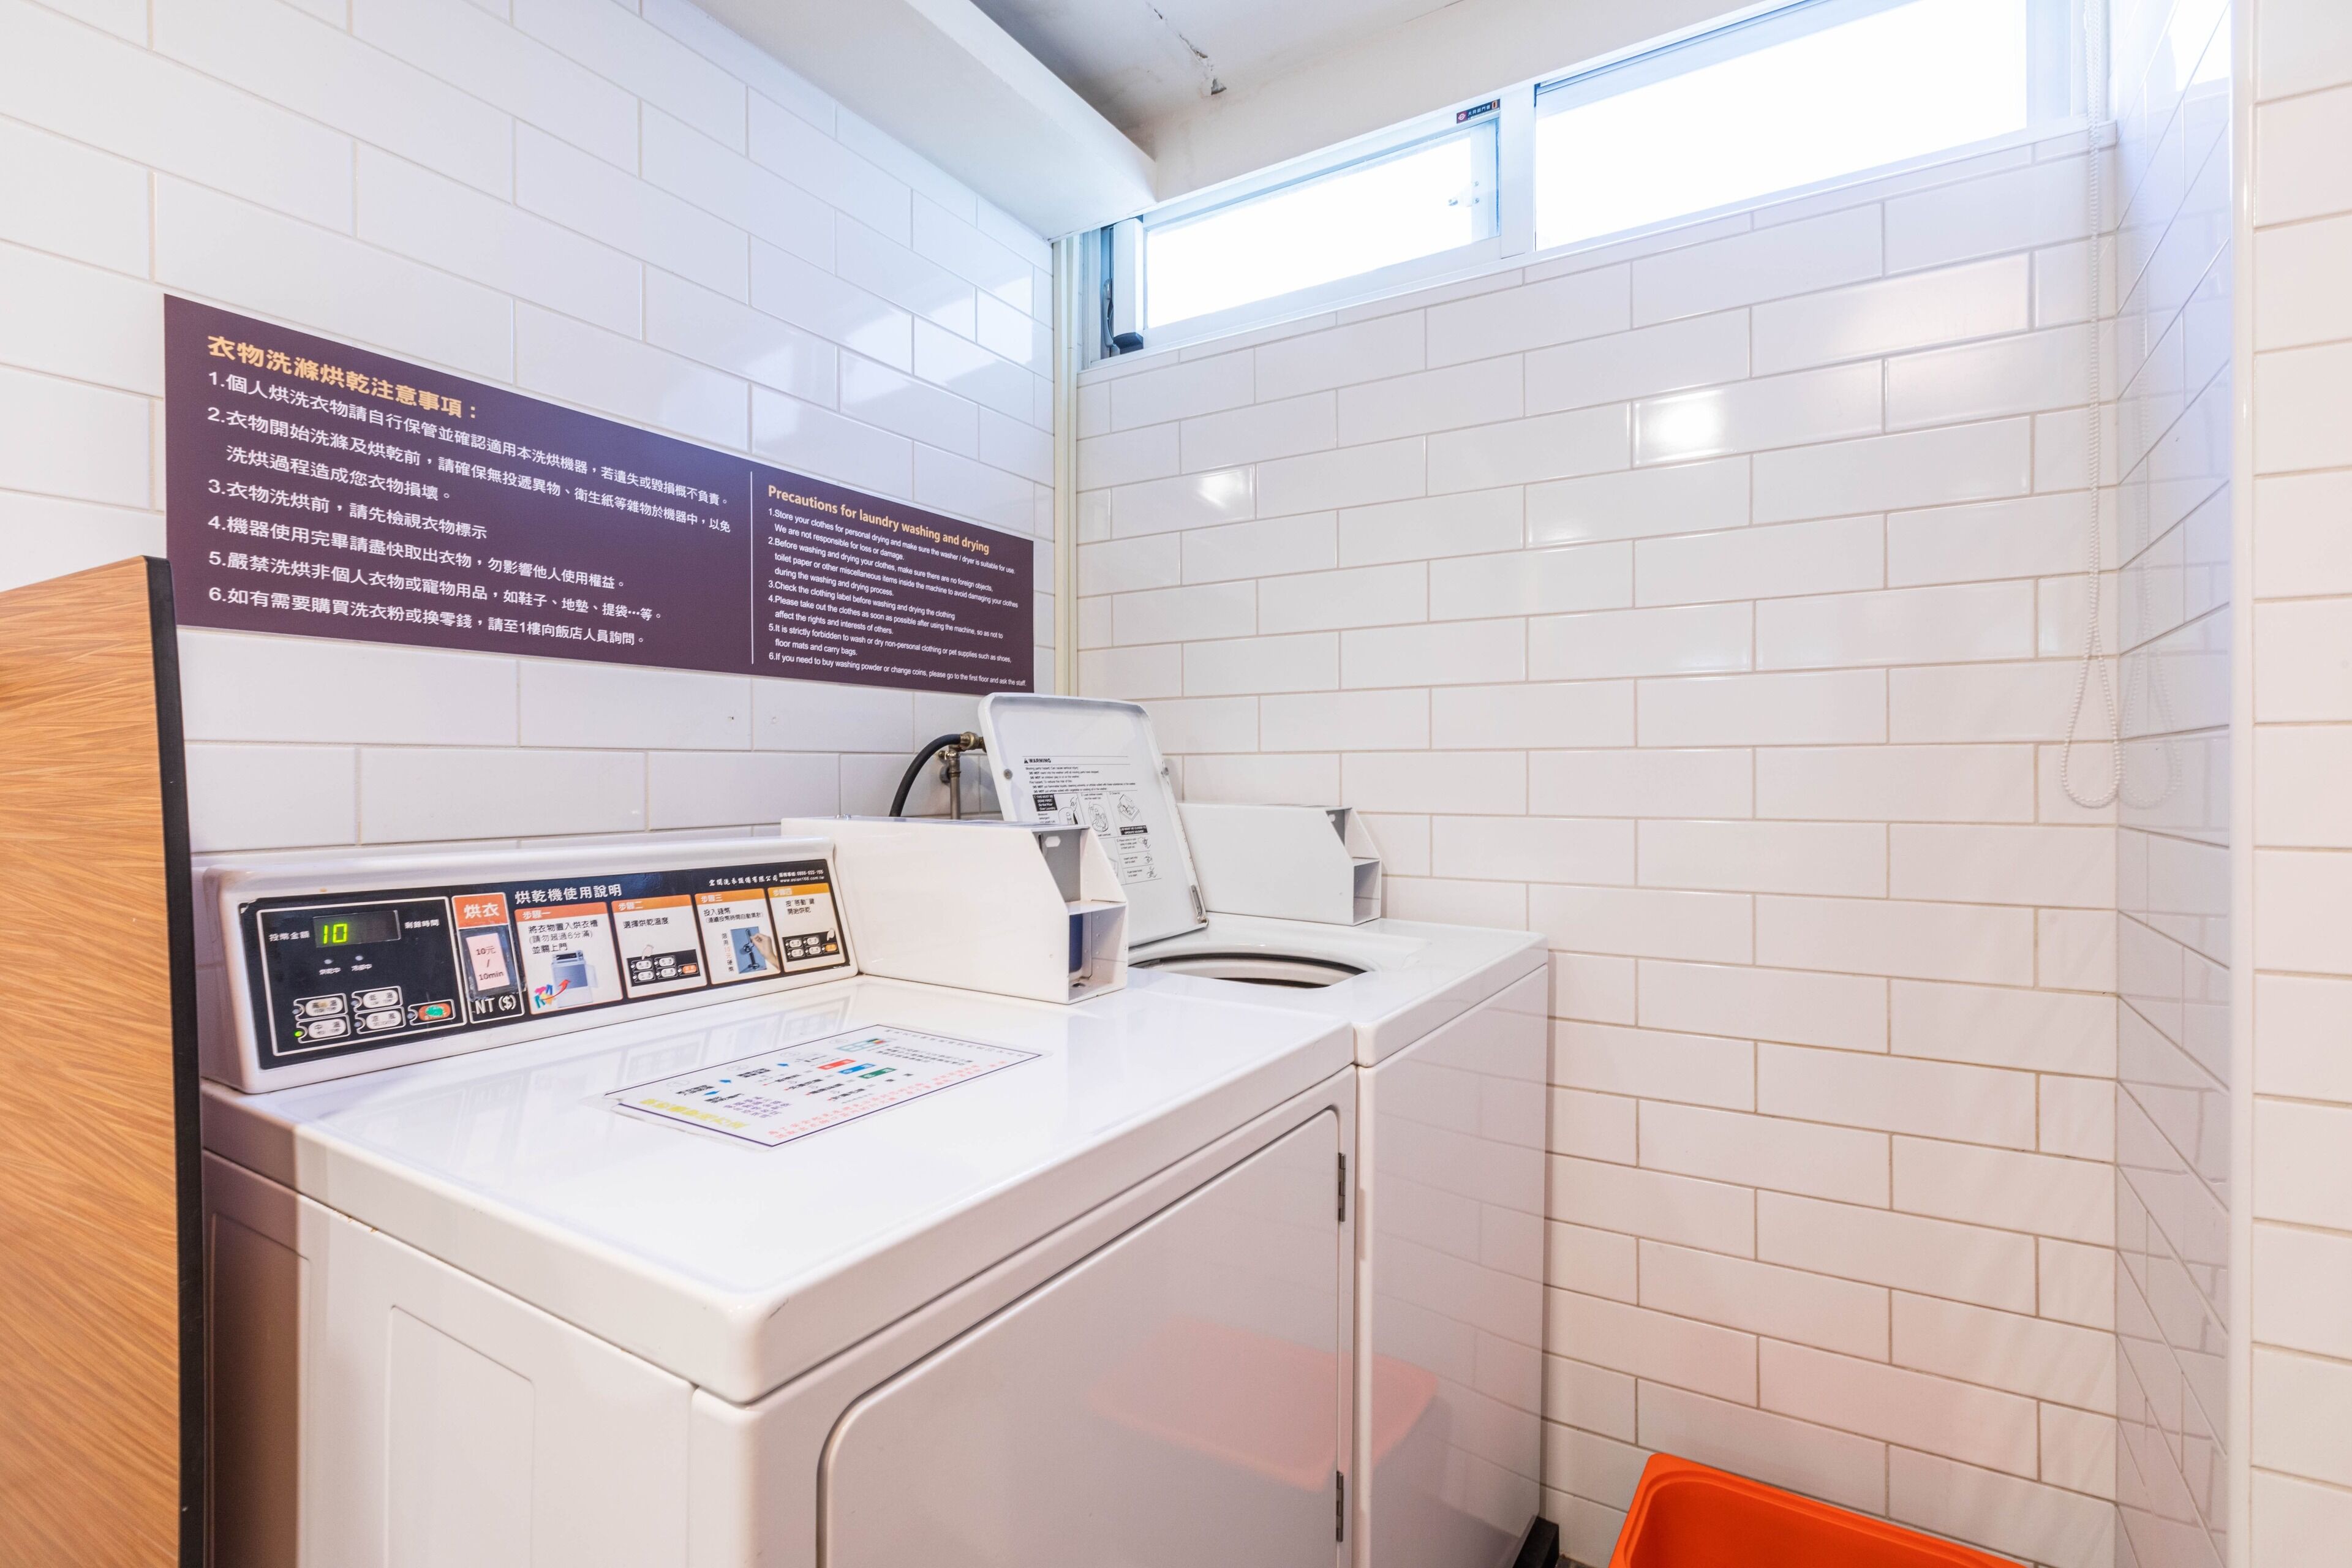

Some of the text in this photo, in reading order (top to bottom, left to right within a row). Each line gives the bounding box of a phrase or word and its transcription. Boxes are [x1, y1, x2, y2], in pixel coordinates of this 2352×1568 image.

[208, 336, 475, 418] 衣物洗滌烘乾注意事項：
[226, 445, 449, 500] 洗烘過程造成您衣物損壞。
[208, 479, 486, 538] 3.衣物洗烘前，請先檢視衣物標示
[768, 484, 989, 556] Precautions for laundry washing and drying
[768, 508, 793, 521] 1.Store
[794, 516, 810, 524] your
[810, 519, 834, 530] clothes
[835, 524, 844, 533] for
[845, 528, 870, 540] personal
[871, 533, 889, 546] drying
[902, 542, 918, 551] make
[930, 548, 940, 556] the
[940, 551, 959, 560] washer
[774, 523, 787, 533] We
[788, 528, 800, 537] are
[813, 534, 849, 548] responsible
[850, 541, 859, 549] for
[859, 543, 872, 553] loss
[880, 549, 904, 561] damage.
[767, 536, 798, 550] 2.Before
[798, 545, 826, 558] washing
[840, 552, 859, 565] drying
[874, 560, 896, 572] clothes,
[897, 566, 913, 575] make
[926, 571, 940, 581] there
[957, 578, 974, 589] foreign
[974, 582, 993, 592] objects,
[774, 552, 791, 563] toilet
[793, 557, 813, 567] paper
[821, 563, 839, 572] other
[839, 567, 881, 581] miscellaneous
[882, 575, 898, 584] items
[898, 578, 915, 587] inside
[925, 584, 948, 594] machine
[968, 592, 991, 604] damaging
[1002, 600, 1019, 608] clothes
[774, 567, 796, 579] during
[797, 571, 809, 580] the
[810, 575, 837, 587] washing
[850, 581, 869, 593] drying
[870, 586, 894, 596] process.
[767, 594, 799, 606] 4.Please
[800, 600, 815, 609] take
[827, 604, 838, 612] the
[839, 606, 861, 616] clothes
[893, 616, 916, 625] possible
[917, 619, 930, 627] after
[930, 622, 944, 631] using
[954, 626, 976, 635] machine,
[768, 579, 797, 592] 3.Check
[797, 586, 809, 594] the
[810, 588, 835, 600] clothing
[836, 592, 851, 601] label
[852, 595, 872, 605] before
[872, 600, 896, 611] washing
[908, 605, 925, 616] drying
[935, 610, 956, 621] clothing
[774, 610, 794, 620] affect
[795, 613, 807, 622] the
[807, 615, 826, 625] rights
[840, 619, 866, 630] interests
[873, 625, 894, 635] others.
[768, 623, 780, 632] 5.It
[781, 625, 788, 633] is
[788, 627, 811, 638] strictly
[811, 628, 842, 640] forbidden
[874, 638, 884, 647] dry
[884, 641, 921, 650] non-personal
[921, 644, 942, 655] clothing
[996, 655, 1011, 663] shoes,
[775, 638, 791, 647] floor
[823, 646, 840, 655] carry
[840, 646, 858, 657] bags.
[769, 652, 781, 660] 6.If
[822, 658, 834, 668] buy
[834, 660, 860, 671] washing
[891, 666, 911, 676] change
[911, 668, 928, 677] coins,
[464, 903, 499, 919] 烘衣
[514, 884, 622, 905] 烘乾機使用說明
[323, 924, 347, 944] 10
[528, 920, 598, 933] 將衣物置入烘衣槽
[477, 946, 496, 956] 10元
[479, 971, 505, 981] 10min
[475, 994, 516, 1015] NT ($)
